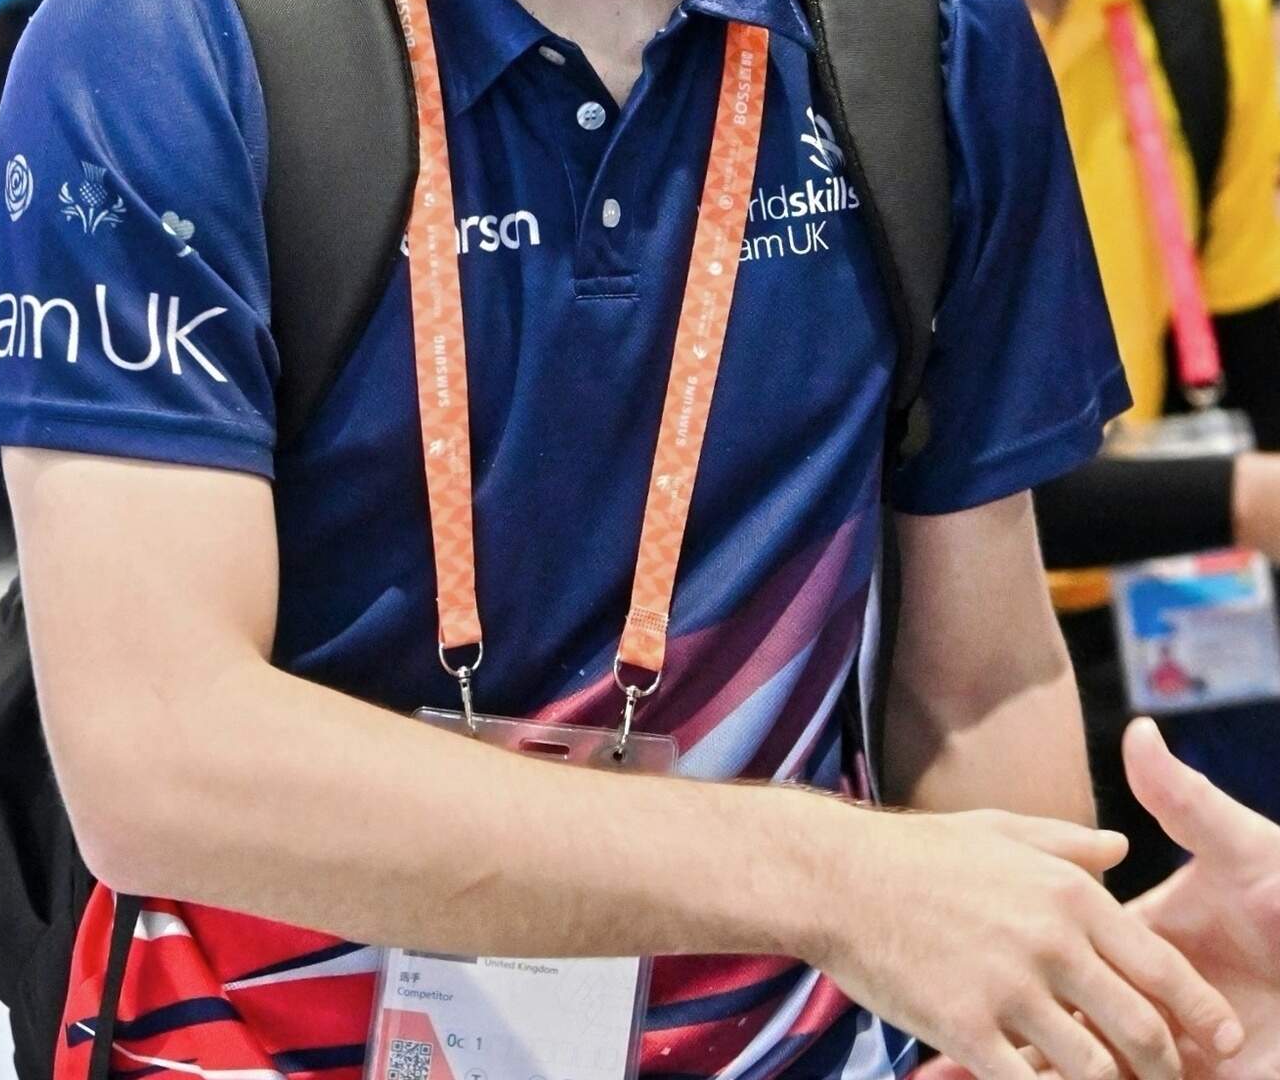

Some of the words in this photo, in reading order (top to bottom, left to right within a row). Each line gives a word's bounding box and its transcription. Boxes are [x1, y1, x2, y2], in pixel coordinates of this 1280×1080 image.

[697, 177, 860, 223] rldskills
[400, 210, 540, 256] rson
[739, 234, 784, 262] am
[787, 221, 829, 255] UK
[95, 284, 228, 383] UK
[434, 334, 451, 408] SAMSUNG
[676, 376, 698, 446] SAMSUNG
[484, 958, 516, 971] United
[517, 962, 559, 976] Kingdom
[397, 987, 454, 1002] Competitor
